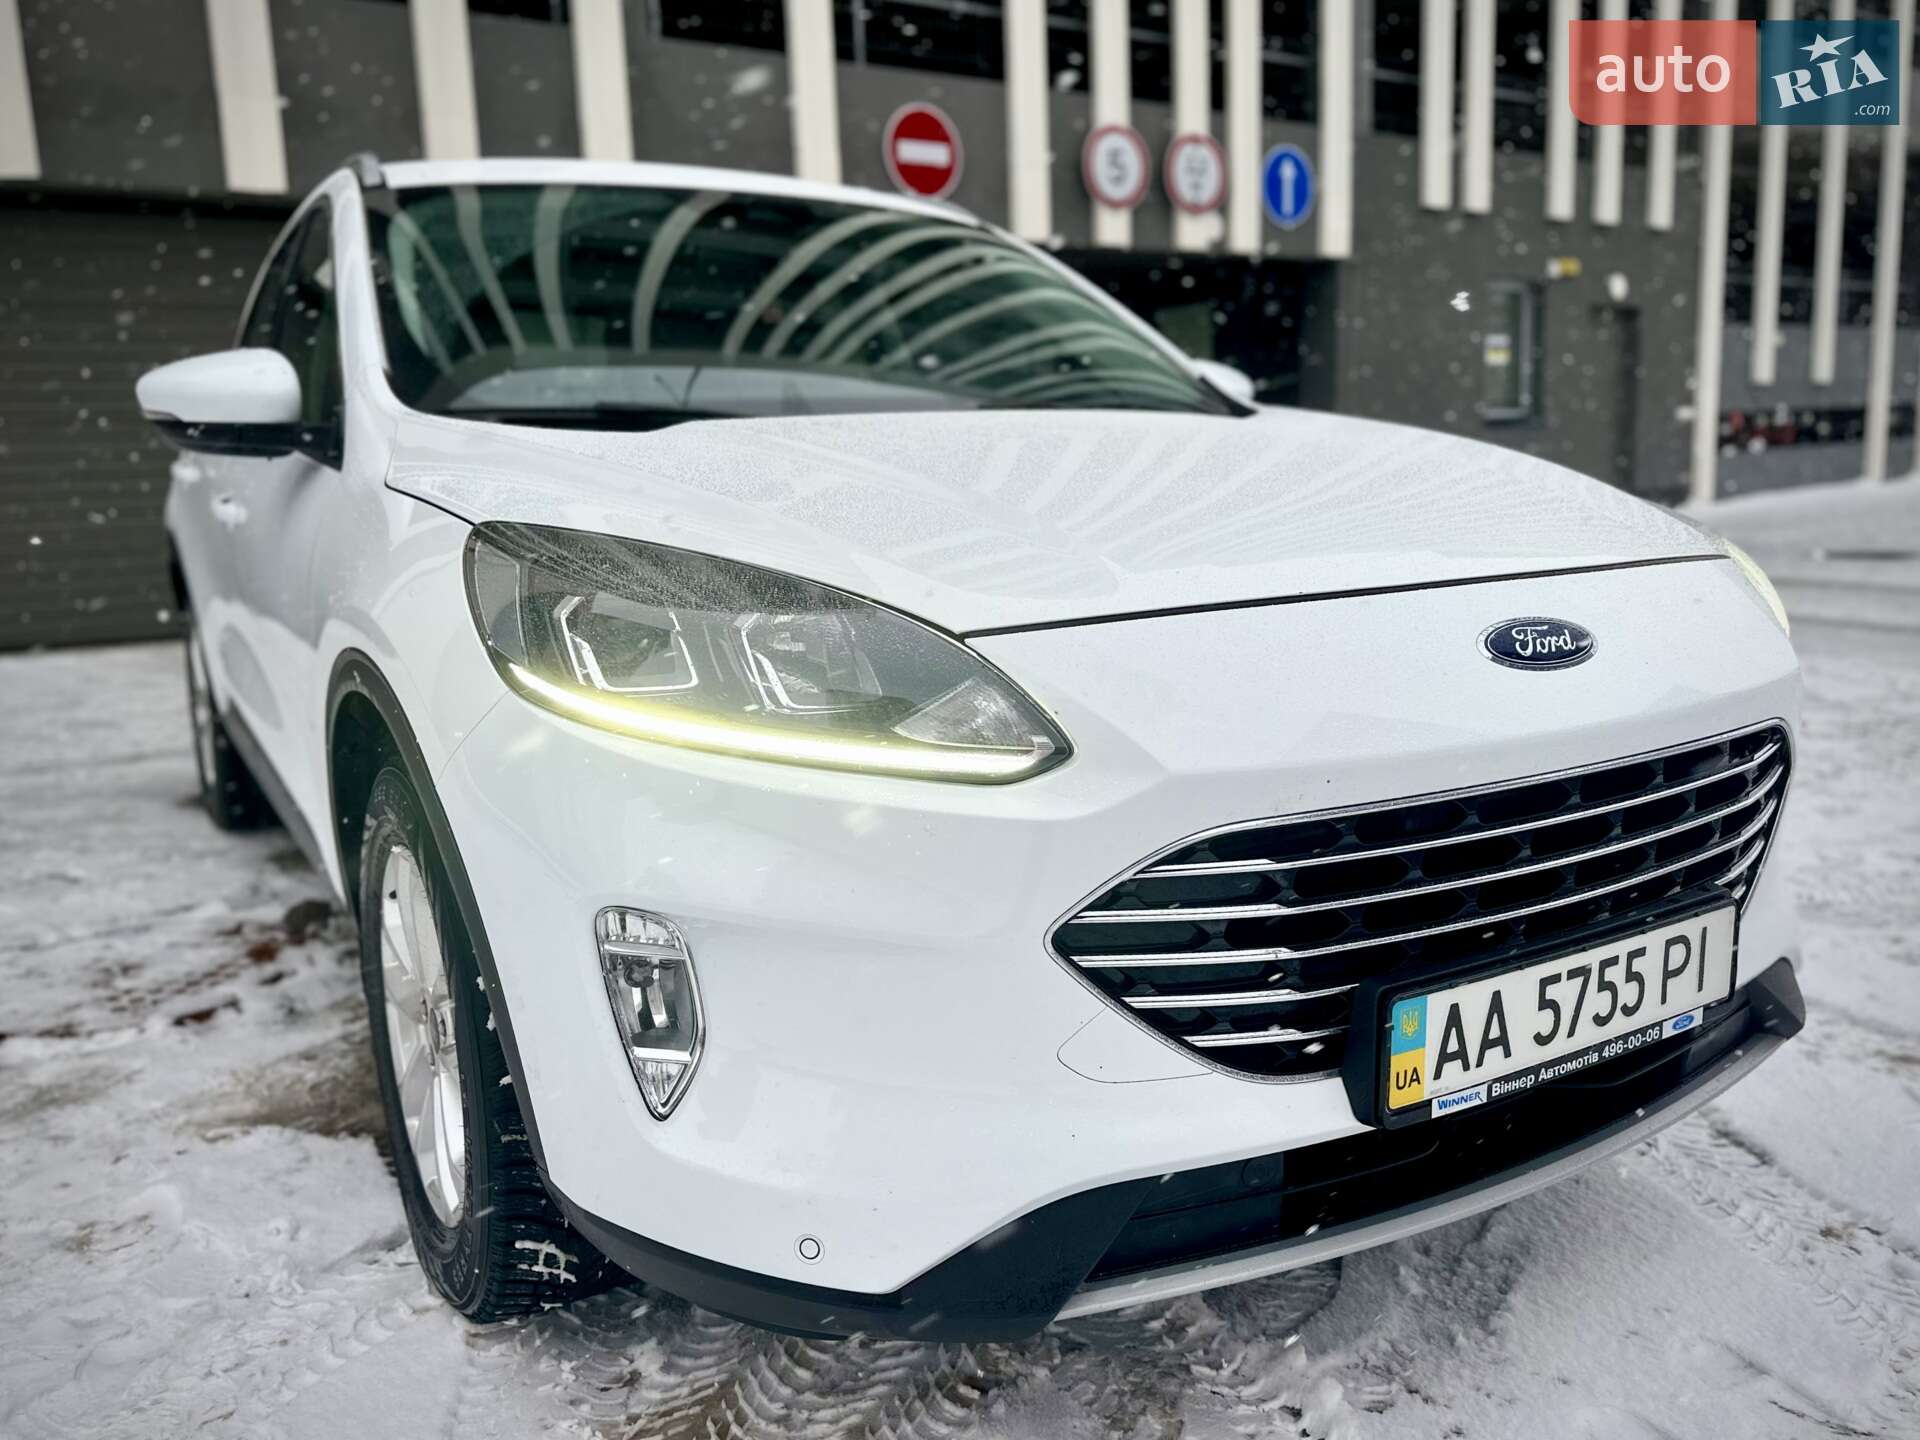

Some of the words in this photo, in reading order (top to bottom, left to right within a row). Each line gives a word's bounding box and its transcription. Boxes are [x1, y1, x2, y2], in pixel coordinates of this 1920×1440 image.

[1106, 147, 1128, 187] 5
[1511, 625, 1576, 657] Ford
[1432, 989, 1512, 1081] AA
[1532, 945, 1647, 1047] 5755
[1660, 926, 1708, 1006] PI
[1395, 1066, 1422, 1091] UA
[1491, 1074, 1535, 1098] Віннер
[1538, 1052, 1600, 1082] Автомотів
[1601, 1026, 1661, 1059] 496-00-06
[1437, 1090, 1484, 1111] WINNER
